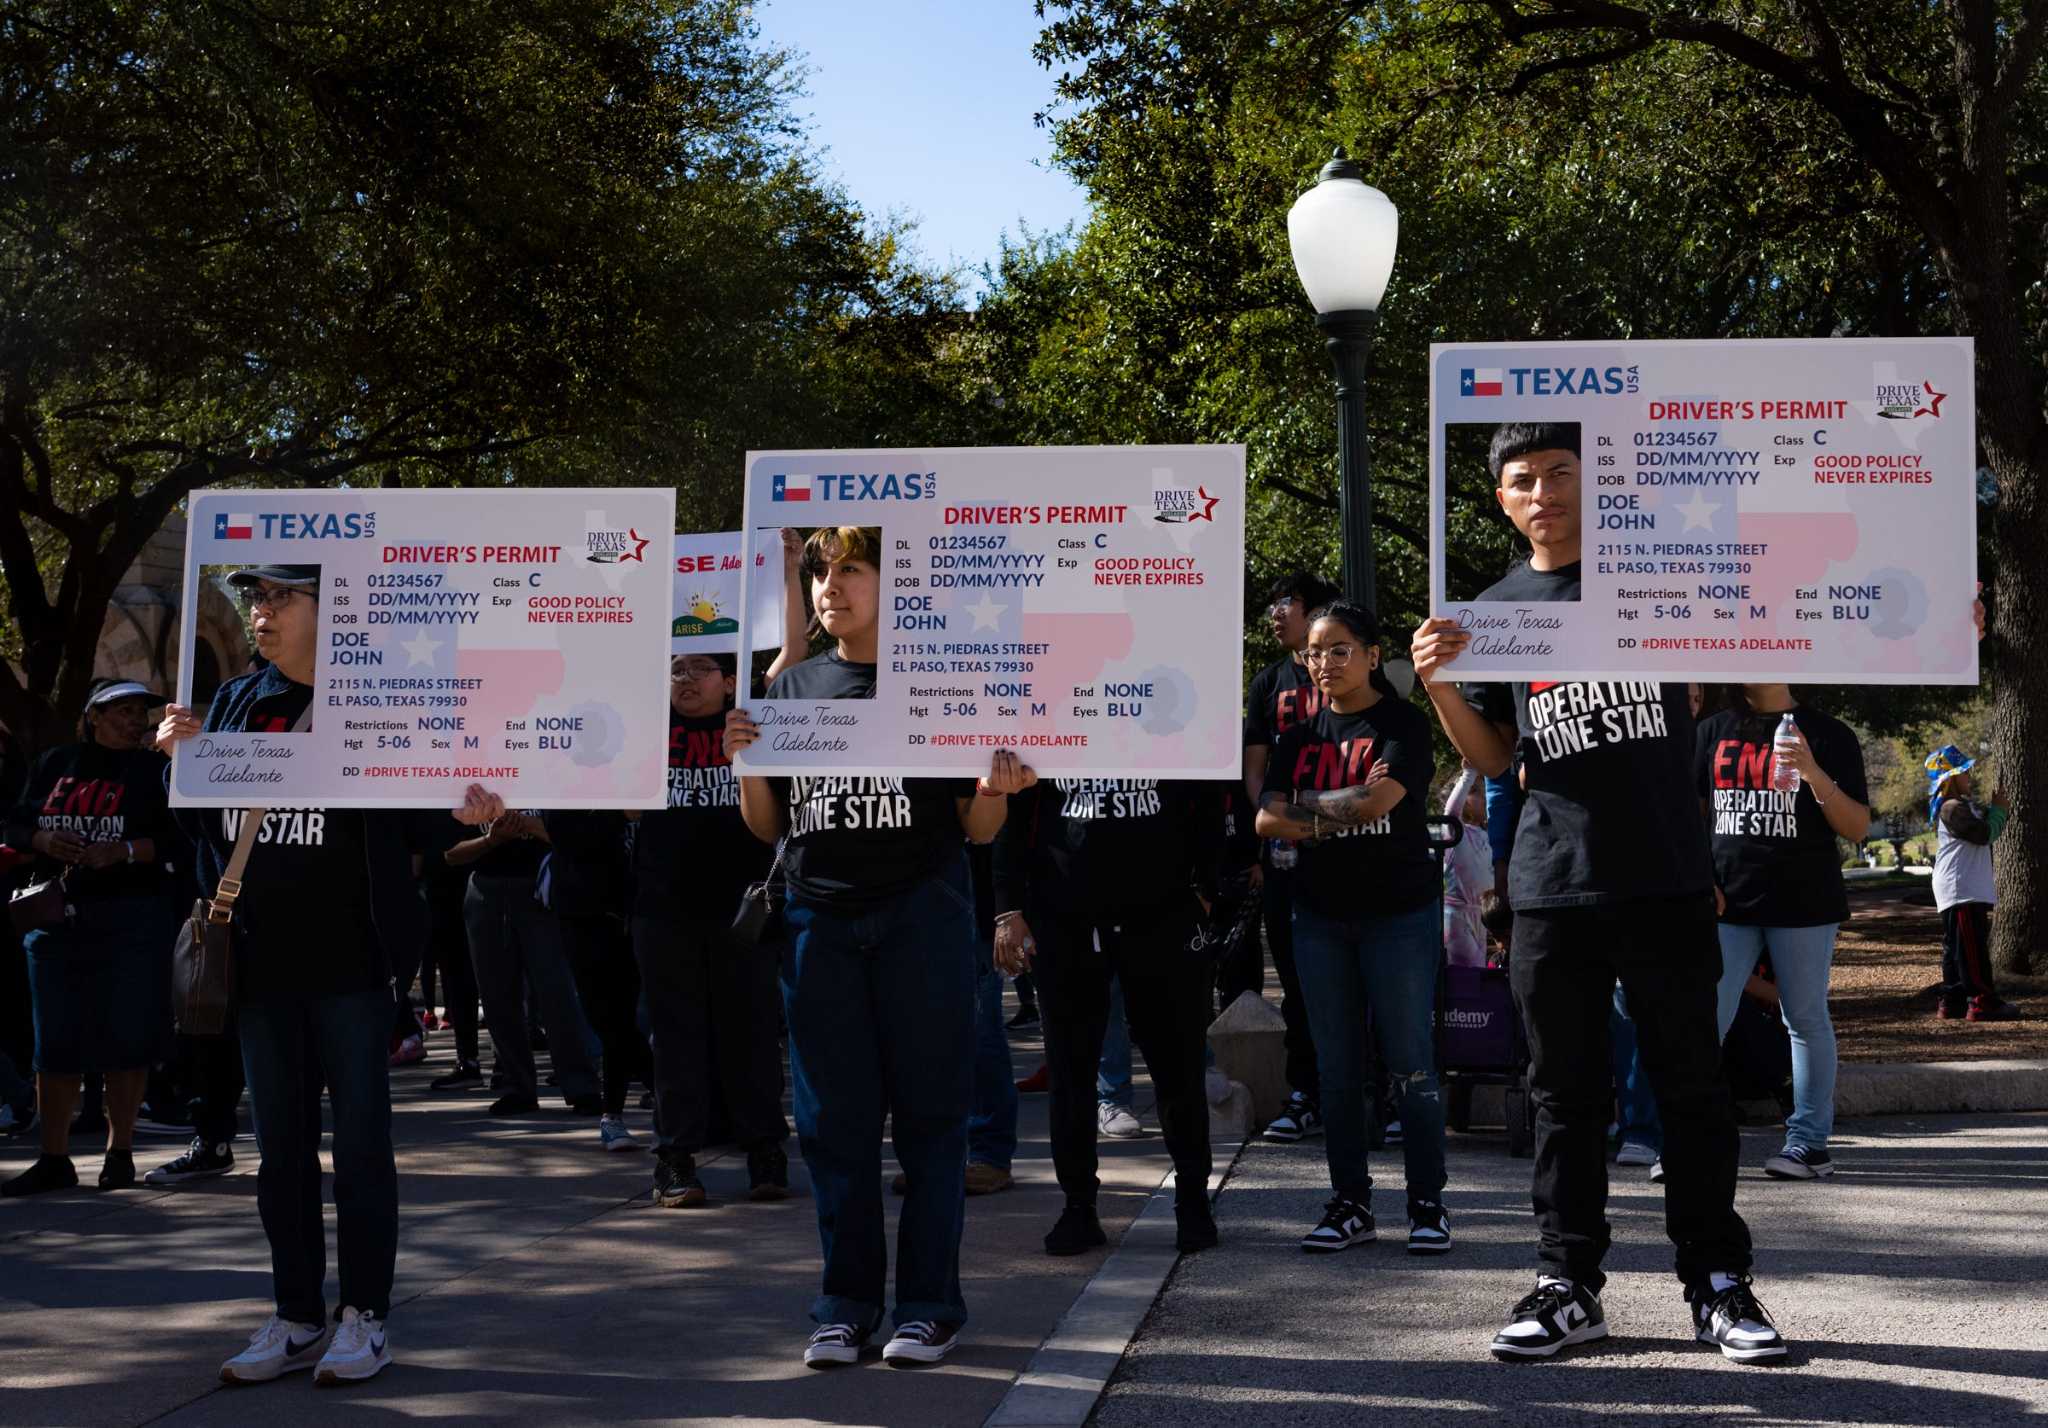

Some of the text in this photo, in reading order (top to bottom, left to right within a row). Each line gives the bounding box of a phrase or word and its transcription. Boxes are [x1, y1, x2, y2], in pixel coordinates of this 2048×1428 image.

[1509, 367, 1623, 395] TEXAS
[1627, 366, 1639, 393] USA
[1877, 385, 1921, 398] DRIVE
[1877, 396, 1921, 407] TEXAS
[1650, 401, 1847, 420] DRIVER'S PERMIT
[1598, 430, 1826, 446] DL 01234567 Class C
[1598, 452, 1795, 466] ISS DD/MM/YYYY Exp
[1815, 456, 1922, 468] GOOD POLICY
[1598, 471, 1760, 486] DOB DD/MM/YYYY
[1815, 471, 1932, 483] NEVER EXPIRES
[817, 474, 921, 500] TEXAS
[925, 472, 936, 499] USA
[1155, 490, 1195, 501] DRIVE
[1598, 495, 1639, 510] DOE
[1154, 500, 1195, 511] TEXAS
[945, 506, 1127, 524] DRIVER'S PERMIT
[1598, 514, 1654, 529] JOHN
[259, 513, 361, 539] TEXAS
[364, 512, 376, 538] USA
[587, 531, 627, 543] DRIVE
[896, 534, 1107, 549] DL 01234567 Class C
[587, 541, 626, 552] TEXAS
[1598, 544, 1768, 555] 2115 N. PIEDRAS STREET
[383, 546, 561, 563] DRIVER'S PERMIT
[896, 555, 1077, 569] ISS DD/MM/YYYY Exp
[1095, 558, 1194, 570] GOOD POLICY
[1598, 562, 1751, 574] EL PASO, TEXAS 79930
[335, 573, 541, 587] DL 01234567 Class C
[895, 574, 1044, 588] DOB DD/MM/YYYY
[1095, 573, 1203, 585] NEVER EXPIRES
[1618, 585, 1881, 600] Restrictions NONE End NONE
[334, 593, 511, 607] ISS DD/MM/YYYY Exp
[529, 597, 625, 608] GOOD POLICY
[895, 596, 932, 611] DOE
[333, 611, 479, 624] DOB DD/MM/YYYY
[528, 611, 633, 623] NEVER EXPIRES
[1459, 609, 1563, 629] Drive Texas
[1618, 605, 1869, 621] Hgt 5-06 Sex M Eyes BLU
[675, 624, 704, 634] ARISE
[893, 615, 946, 630] JOHN
[332, 633, 369, 646] DOE
[1472, 635, 1553, 655] Adelante
[1618, 638, 1812, 650] DD #DRIVE TEXAS ADELANTE
[893, 644, 1049, 654] 2115 N. PIEDRAS STREET
[330, 651, 382, 665] JOHN
[893, 661, 1033, 673] EL PASO, TEXAS 79930
[329, 679, 482, 689] 2115 N. PIEDRAS STREET
[910, 684, 1153, 697] Restrictions NONE End NONE
[329, 696, 467, 707] EL PASO, TEXAS 79930
[1528, 681, 1662, 730] OPERATION
[760, 706, 858, 726] Drive Texas
[910, 703, 1141, 718] Hgt 5-06 Sex M Eyes BLU
[345, 717, 583, 730] Restrictions NONE End NONE
[1534, 703, 1668, 763] LONE STAR
[345, 736, 571, 750] Hgt 5-06 Sex M Eyes BLU
[773, 732, 848, 751] Adelante
[909, 735, 1087, 746] DD #DRIVE TEXAS ADELANTE
[195, 739, 294, 758] Drive Texas
[209, 764, 283, 783] Adelante
[343, 767, 519, 777] DD #DRIVE TEXAS ADELANTE
[43, 777, 125, 816] END
[1714, 789, 1798, 814] OPERATION
[1113, 790, 1162, 818] STAR
[845, 795, 912, 829] STAR
[258, 812, 325, 845] STAR
[1750, 814, 1798, 838] STAR
